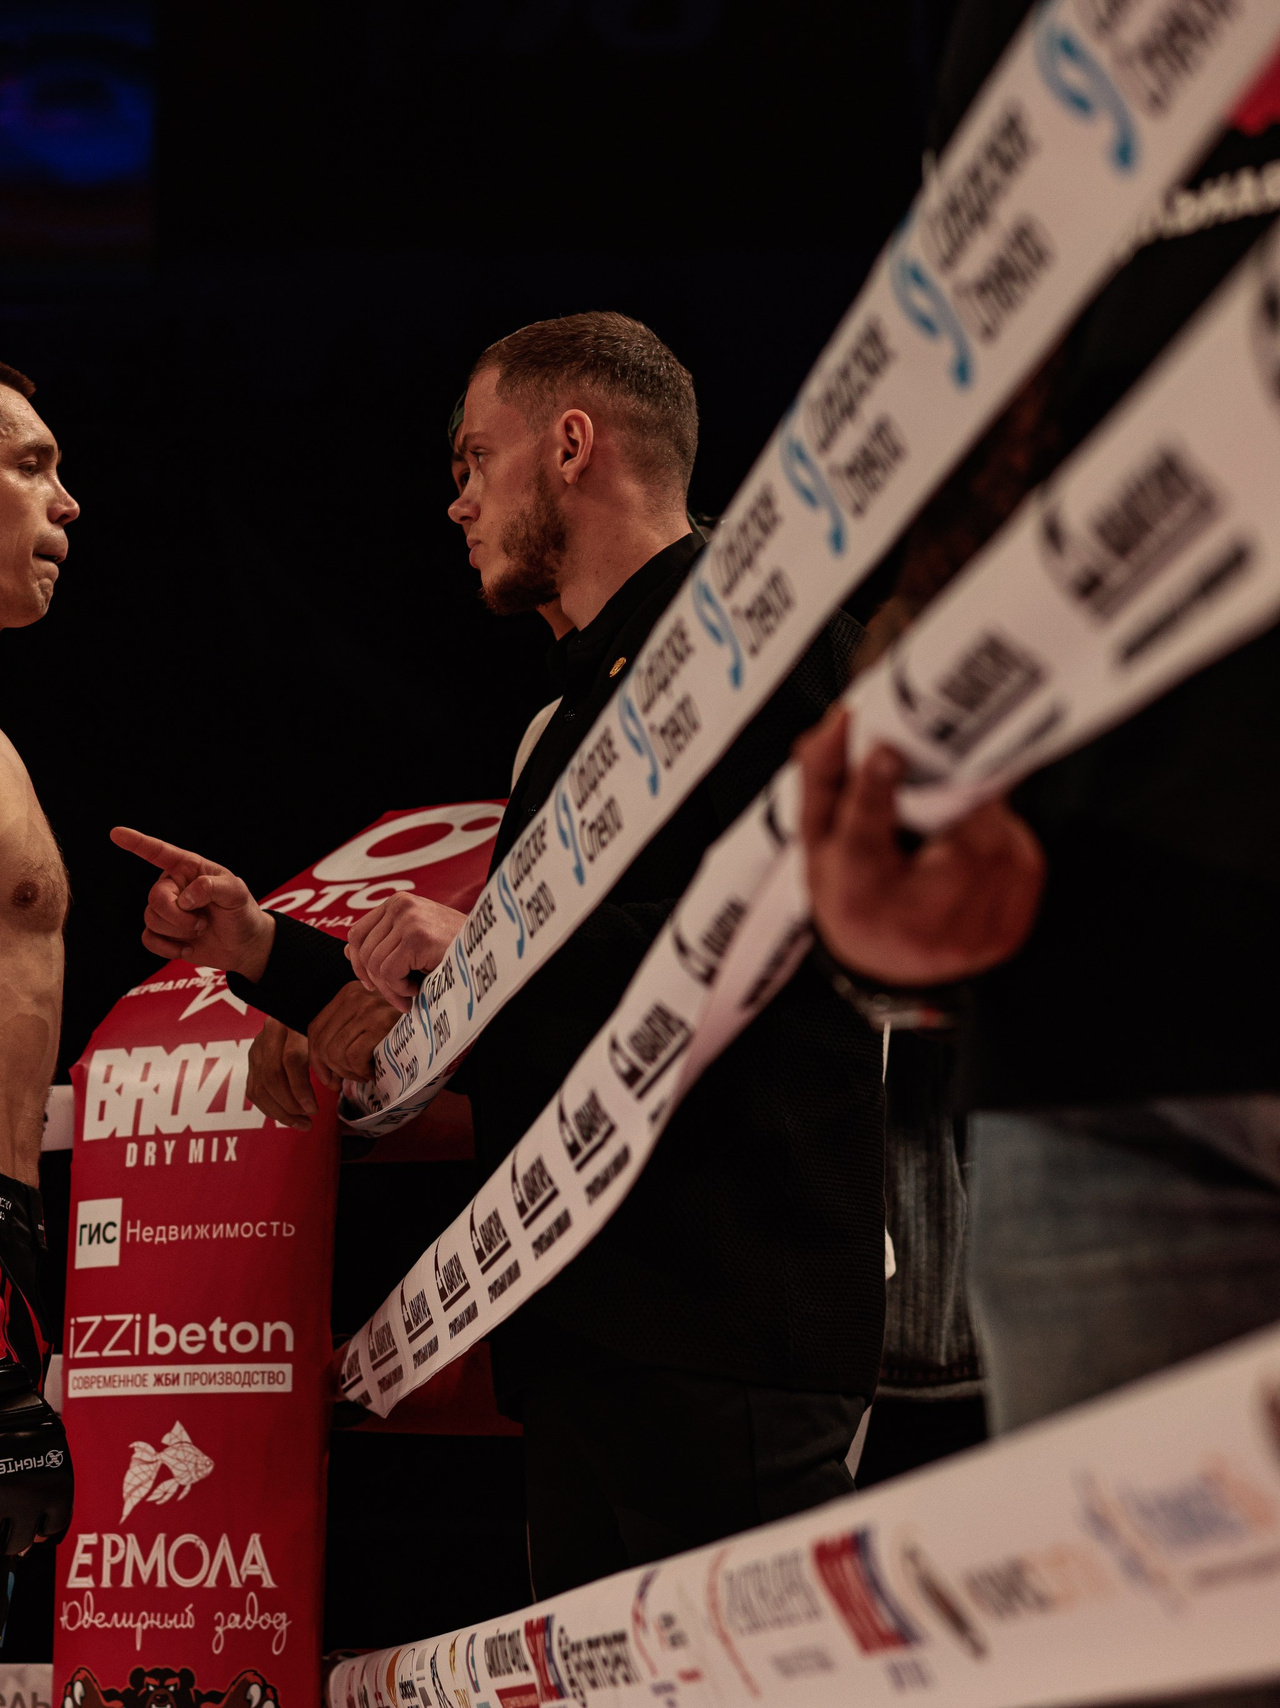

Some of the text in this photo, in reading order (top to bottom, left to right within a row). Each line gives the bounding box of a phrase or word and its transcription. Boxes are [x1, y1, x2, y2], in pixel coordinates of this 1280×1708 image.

[83, 1038, 294, 1141] BROZ
[125, 1136, 238, 1168] DRY MIX
[78, 1219, 296, 1246] ГИС Недвижимость
[73, 1370, 286, 1391] СОВРЕМЕННОЕ ЖБИ ПРОИЗВОДСТВО
[66, 1533, 277, 1589] ЕРМОЛА
[60, 1591, 292, 1655] Ювелирный завод
